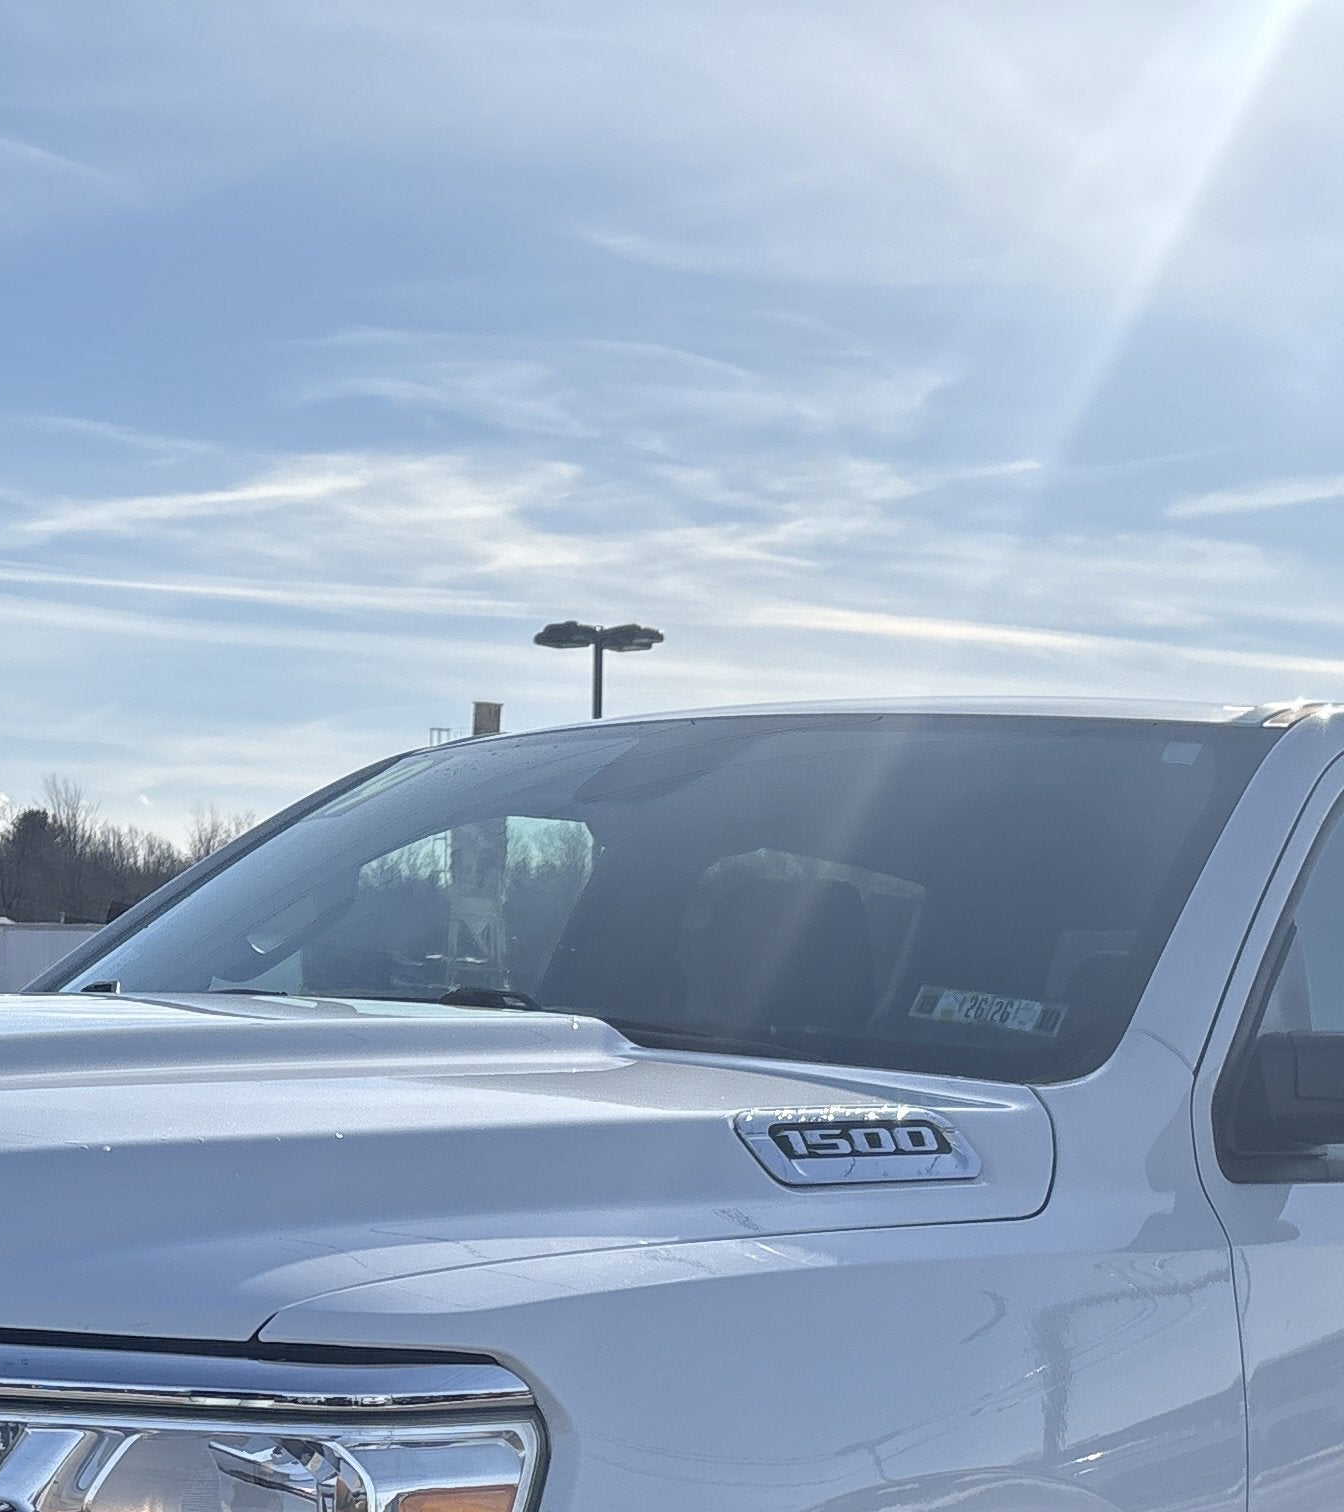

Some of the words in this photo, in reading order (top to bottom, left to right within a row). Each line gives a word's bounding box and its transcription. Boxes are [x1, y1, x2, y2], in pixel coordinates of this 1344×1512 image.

[964, 995, 987, 1019] 26
[990, 1000, 1014, 1024] 26
[776, 1126, 939, 1155] 1500
